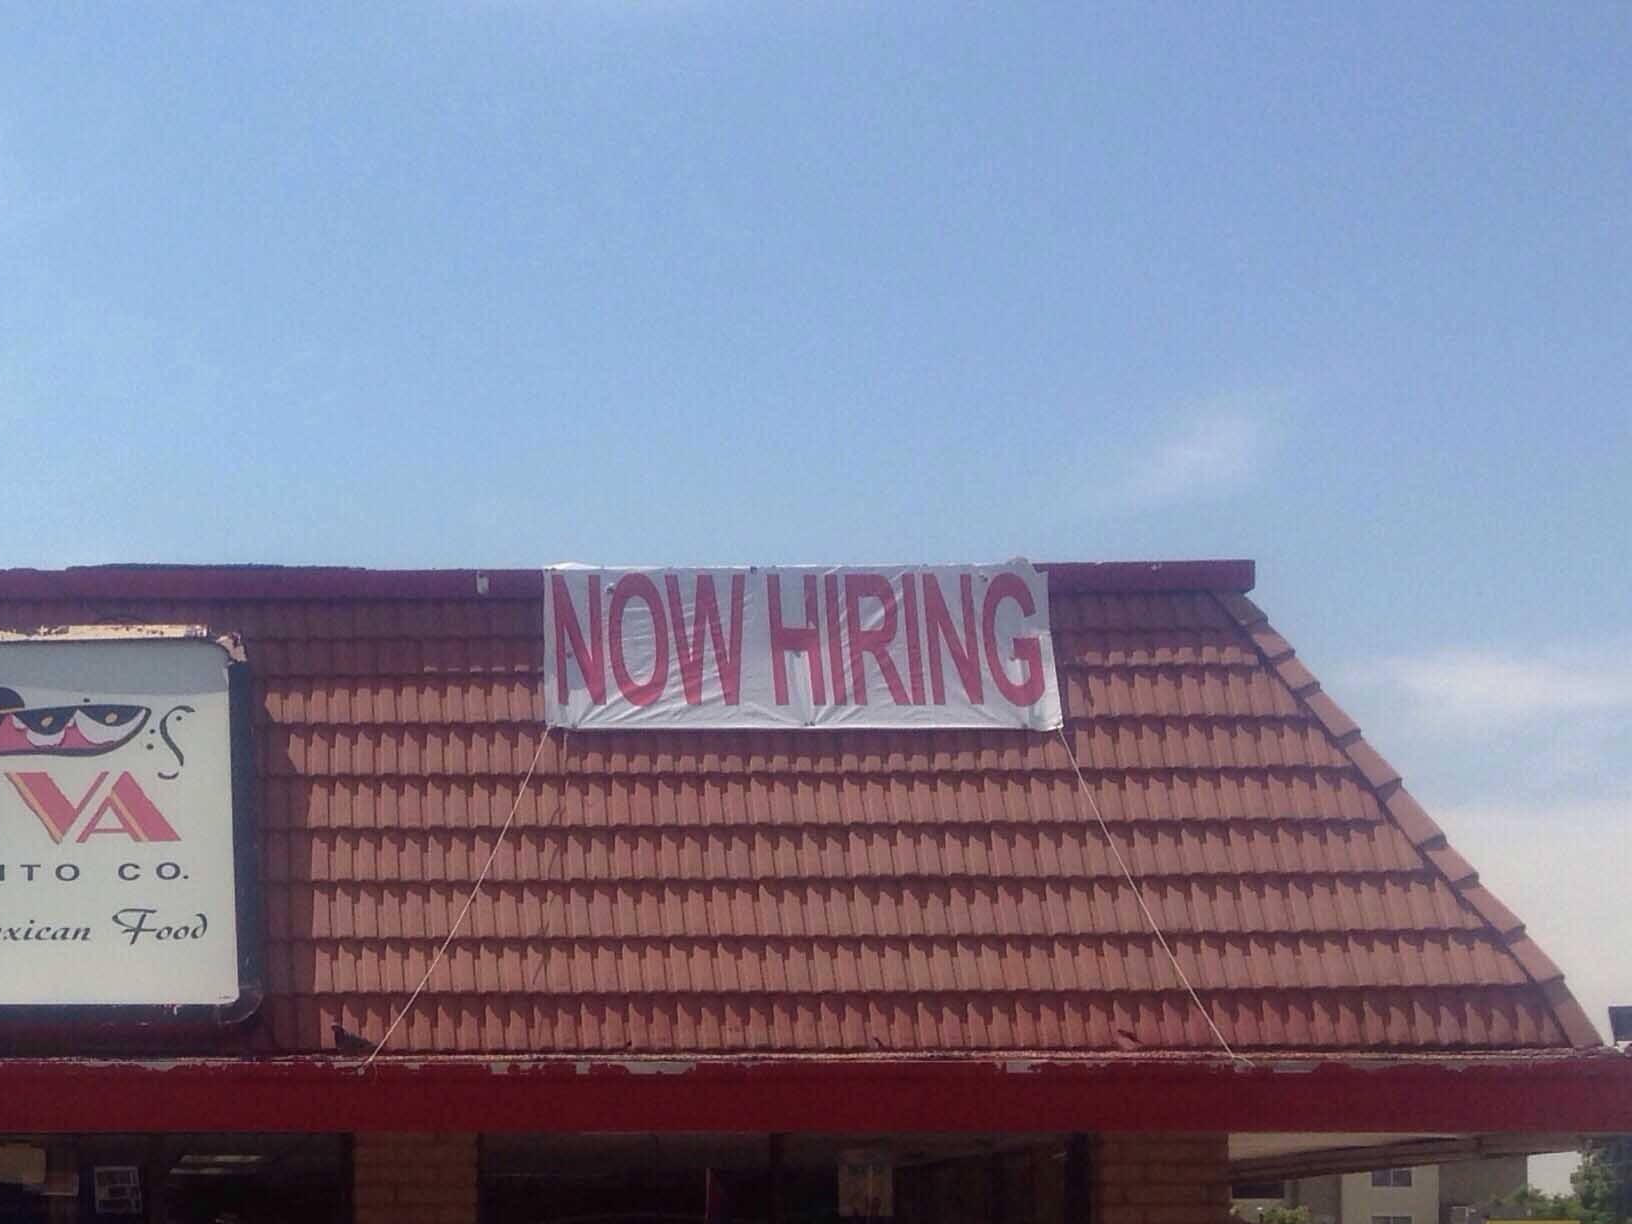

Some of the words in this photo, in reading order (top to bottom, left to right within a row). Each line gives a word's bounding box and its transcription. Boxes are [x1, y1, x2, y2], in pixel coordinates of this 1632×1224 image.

[551, 571, 747, 707] NOW
[768, 571, 1047, 708] HIRING
[117, 861, 190, 882] CO.
[111, 907, 209, 946] Food
